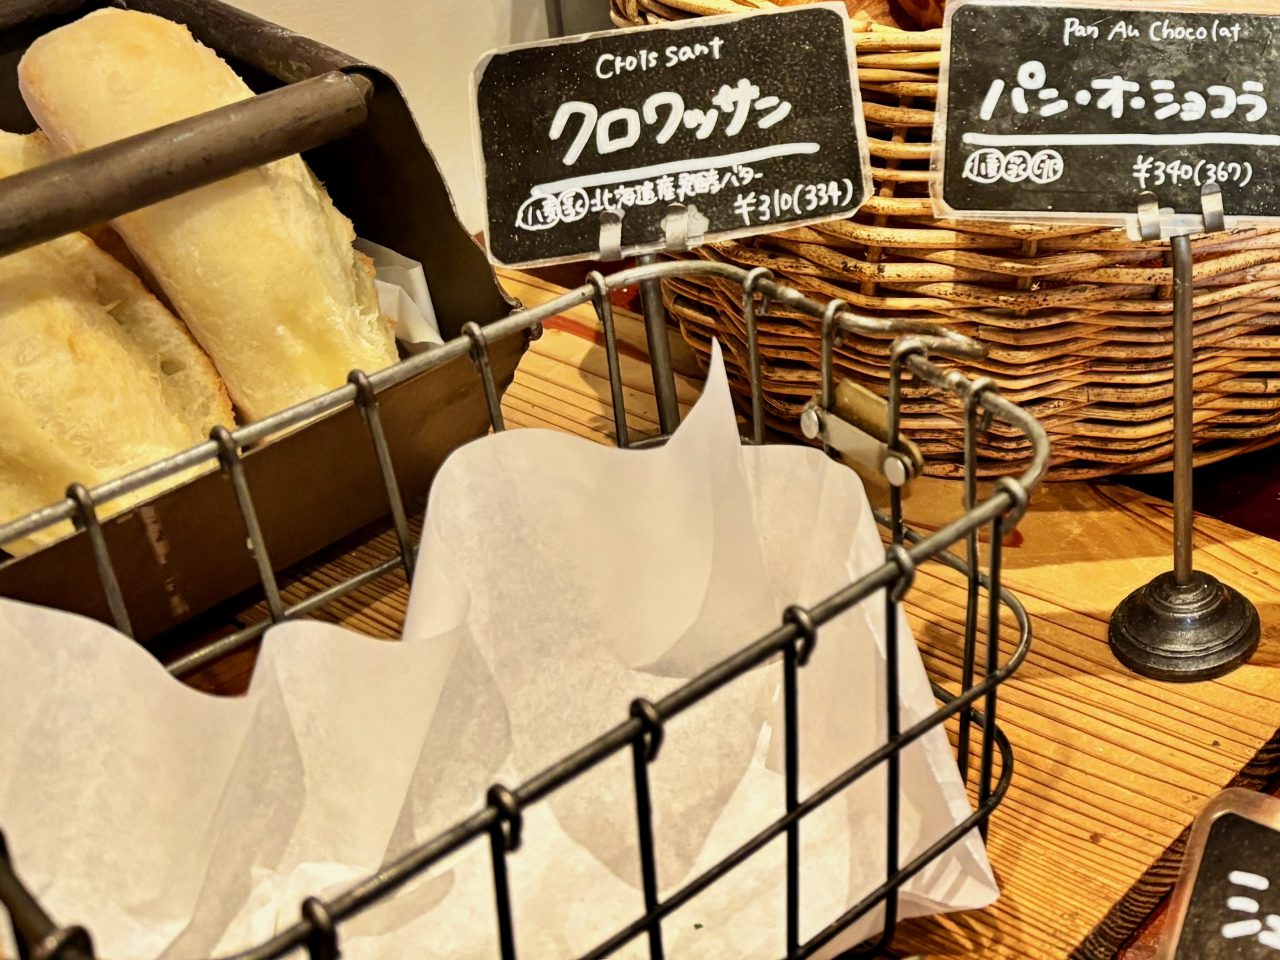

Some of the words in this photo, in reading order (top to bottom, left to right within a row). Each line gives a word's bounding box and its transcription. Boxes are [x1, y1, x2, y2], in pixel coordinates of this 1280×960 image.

[1062, 16, 1099, 46] Pan
[1107, 21, 1139, 41] Au
[549, 78, 792, 165] クロワッサン
[1132, 153, 1254, 190] ¥340(367)
[733, 177, 854, 227] ¥310(334)
